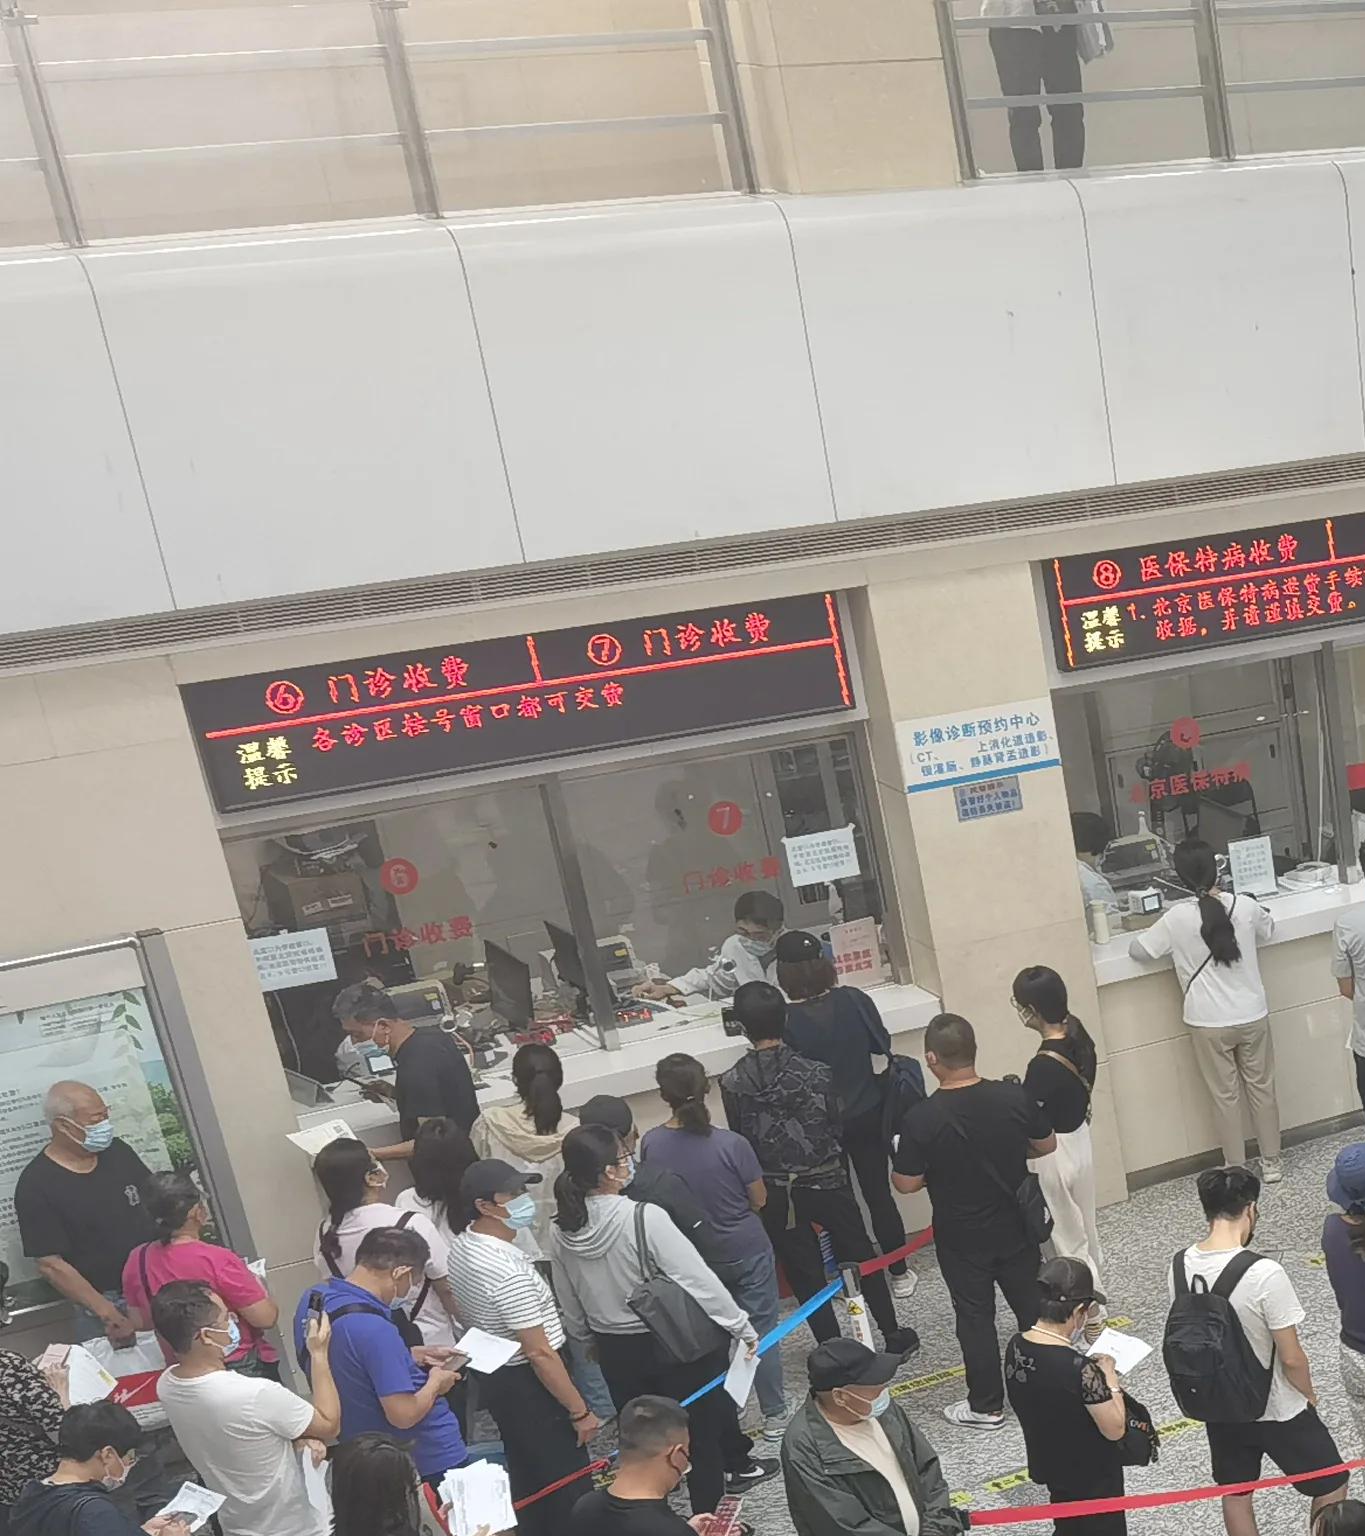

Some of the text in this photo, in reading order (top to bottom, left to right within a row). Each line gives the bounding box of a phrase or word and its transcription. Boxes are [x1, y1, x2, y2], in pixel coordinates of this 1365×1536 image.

[1139, 533, 1298, 582] 医保特病收费
[643, 612, 771, 657] 门诊收费
[327, 655, 470, 704] 门诊收费
[312, 682, 625, 752] 各诊区挂号窗口都可交费
[913, 712, 1040, 747] 影像诊断预约中心
